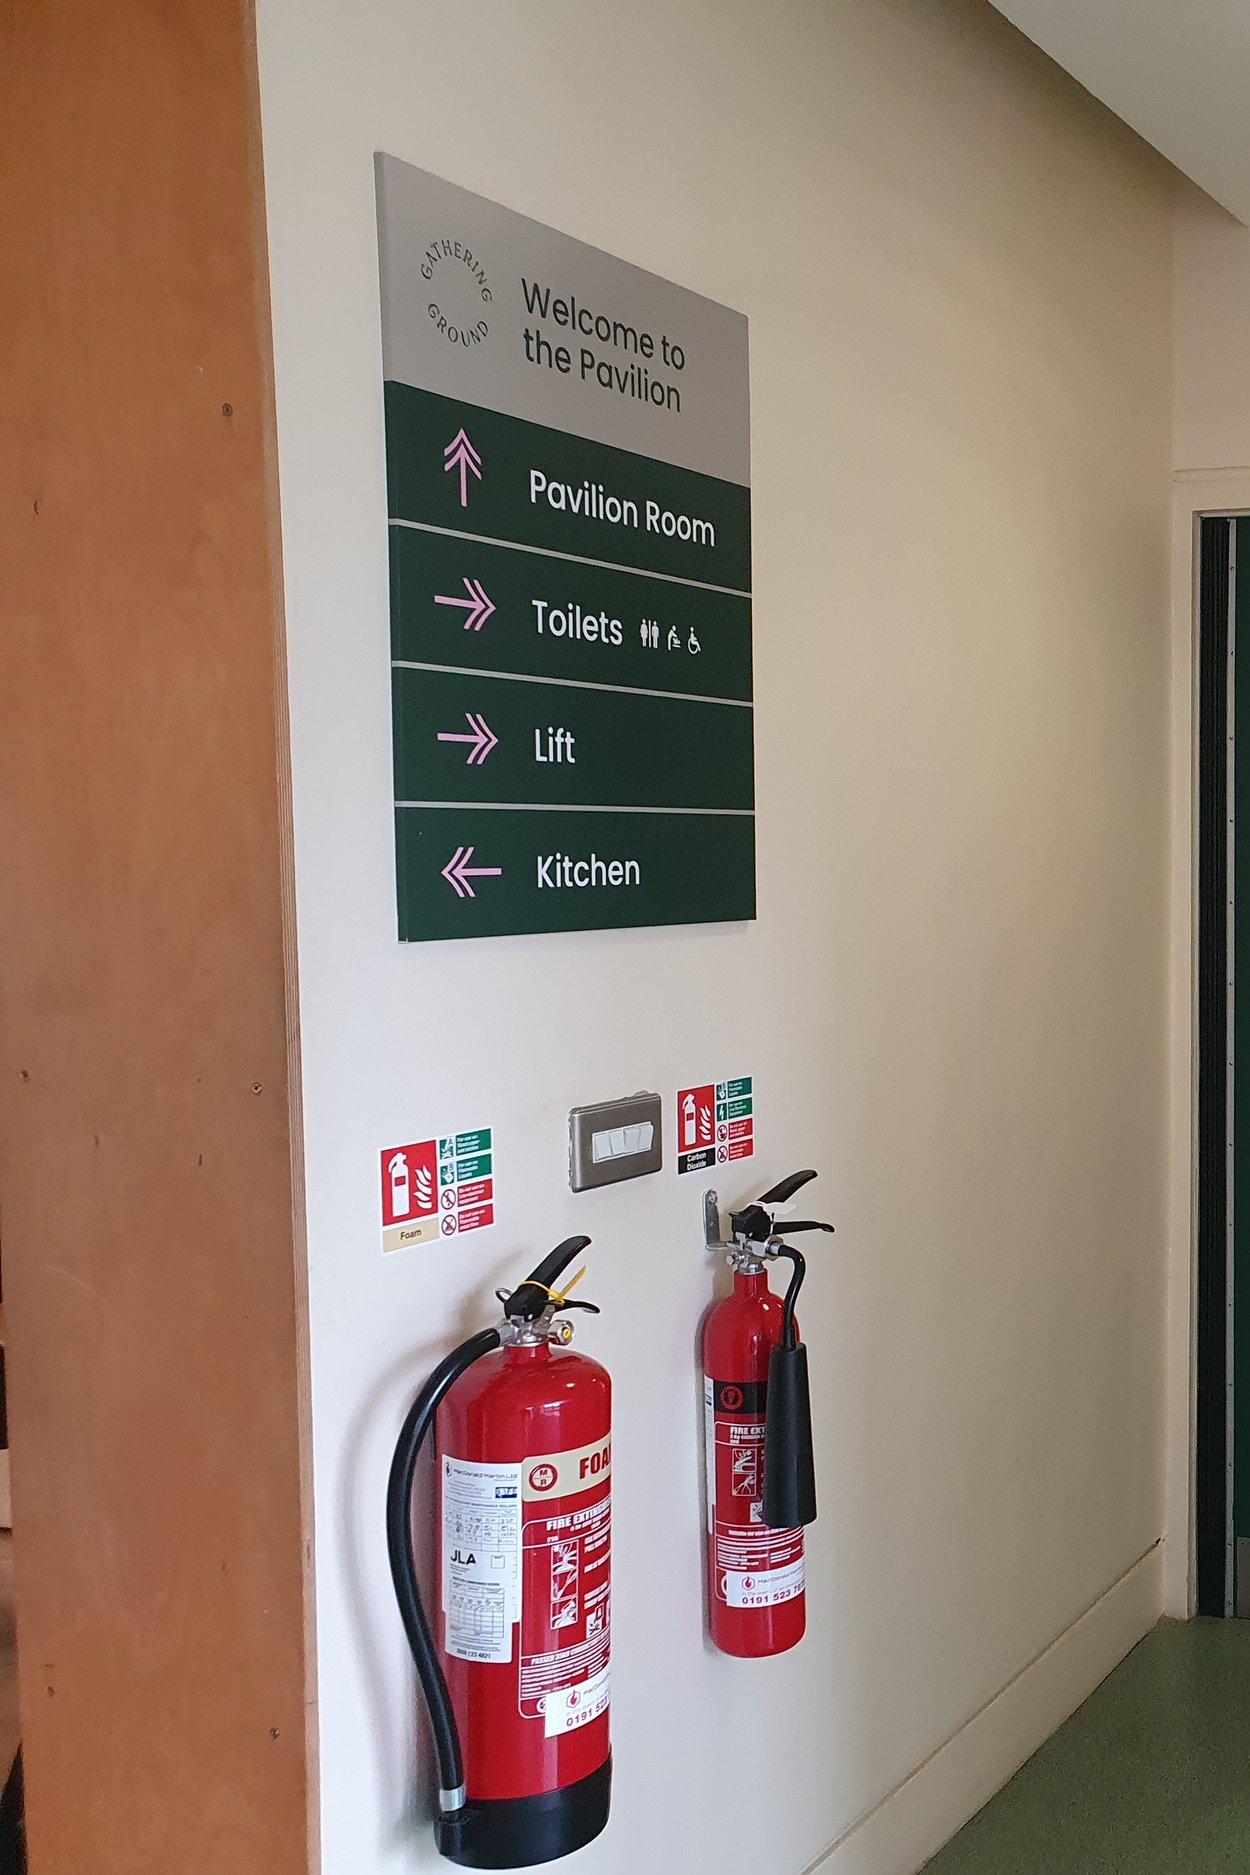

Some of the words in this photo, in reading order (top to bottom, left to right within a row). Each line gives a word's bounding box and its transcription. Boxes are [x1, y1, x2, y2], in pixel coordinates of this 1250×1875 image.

[420, 240, 493, 302] GATHERING
[427, 303, 489, 348] GROUND
[520, 277, 654, 359] Welcome
[661, 335, 686, 370] to
[523, 327, 571, 374] the
[580, 348, 681, 413] Pavilion
[529, 469, 639, 528] Pavilion
[646, 501, 716, 547] Room
[532, 599, 623, 645] Toilets
[534, 727, 576, 765] Lift
[536, 854, 641, 889] Kitchen
[686, 1151, 707, 1163] Carbon
[686, 1160, 707, 1171] Dioxide
[400, 1228, 422, 1241] Foam
[546, 1516, 572, 1531] FIRE
[450, 1549, 476, 1565] JLA
[742, 1595, 769, 1604] 0191
[773, 1589, 791, 1601] 523
[566, 1707, 593, 1727] 0191
